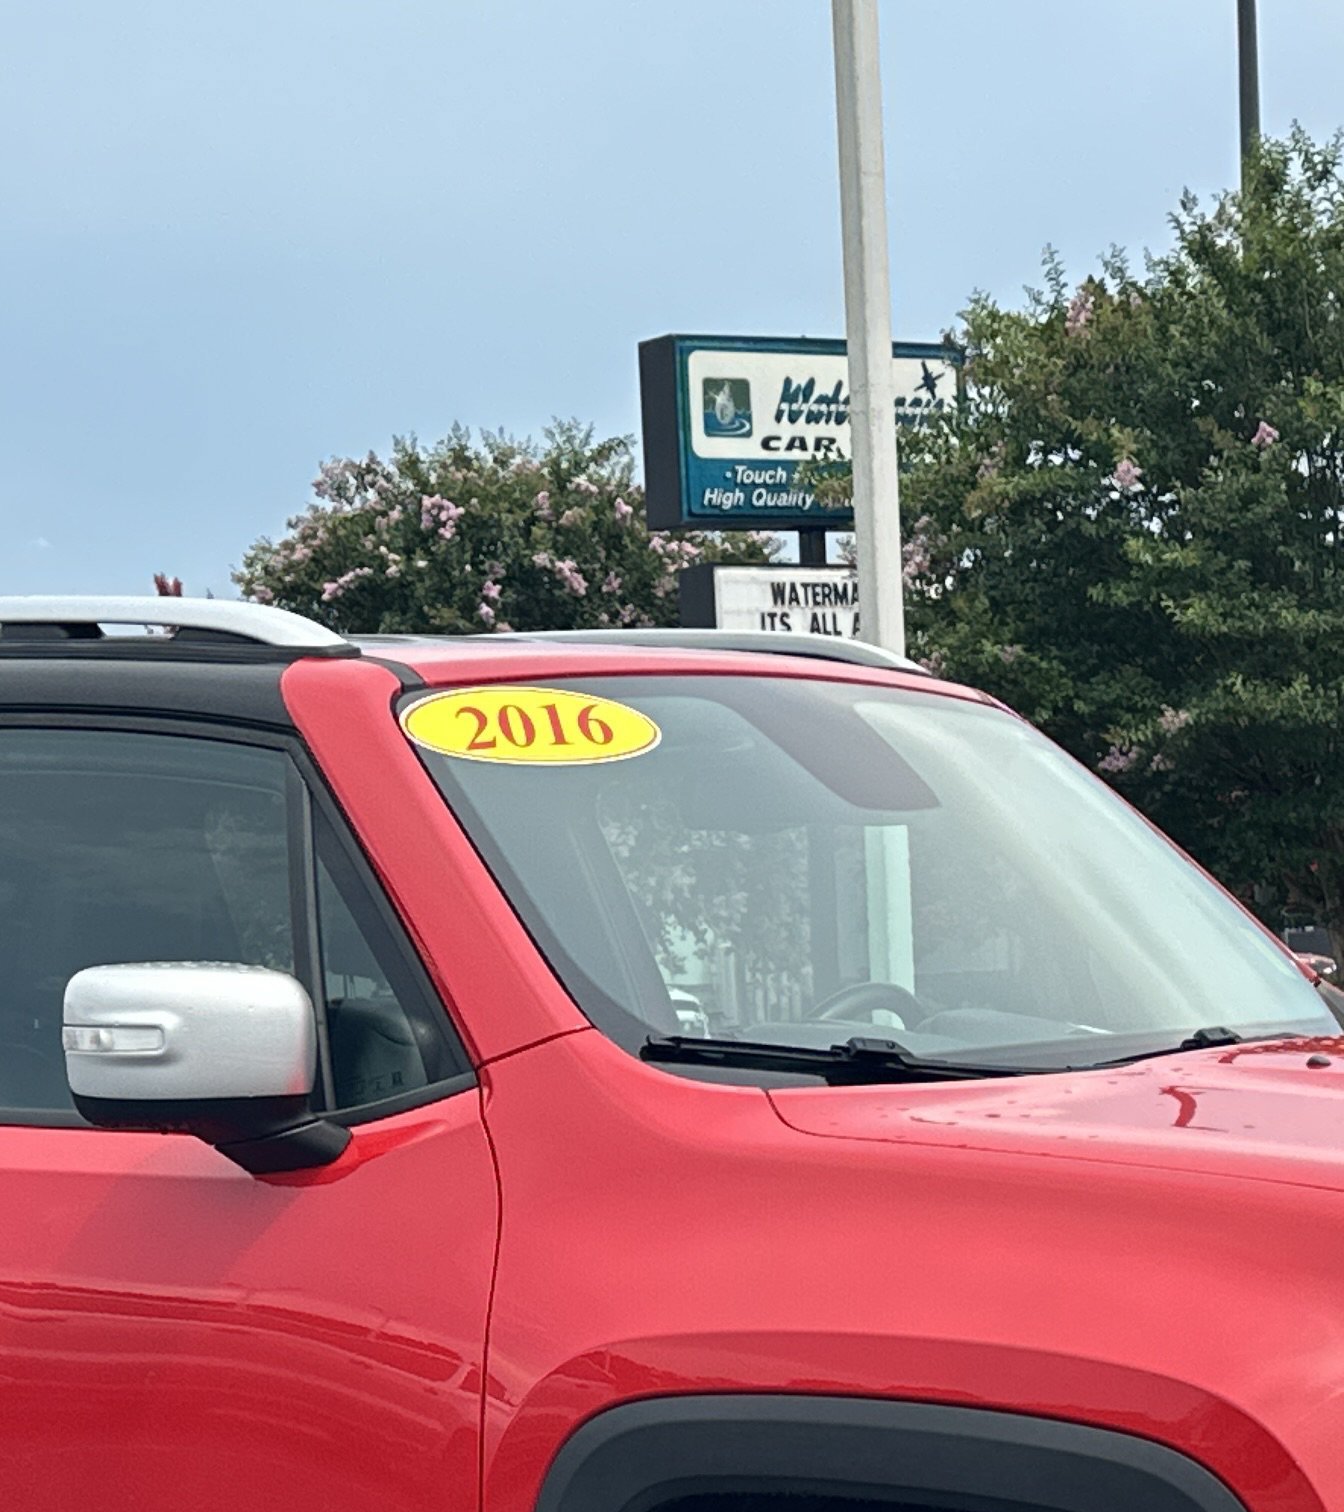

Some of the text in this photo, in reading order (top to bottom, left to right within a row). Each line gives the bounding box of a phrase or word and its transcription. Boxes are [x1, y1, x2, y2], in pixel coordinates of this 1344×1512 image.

[760, 435, 839, 453] CAR
[735, 465, 787, 485] Touch
[704, 487, 745, 511] High
[751, 487, 815, 511] Quality
[760, 612, 792, 632] ITS
[809, 612, 843, 636] ALL
[455, 702, 614, 751] 2016
